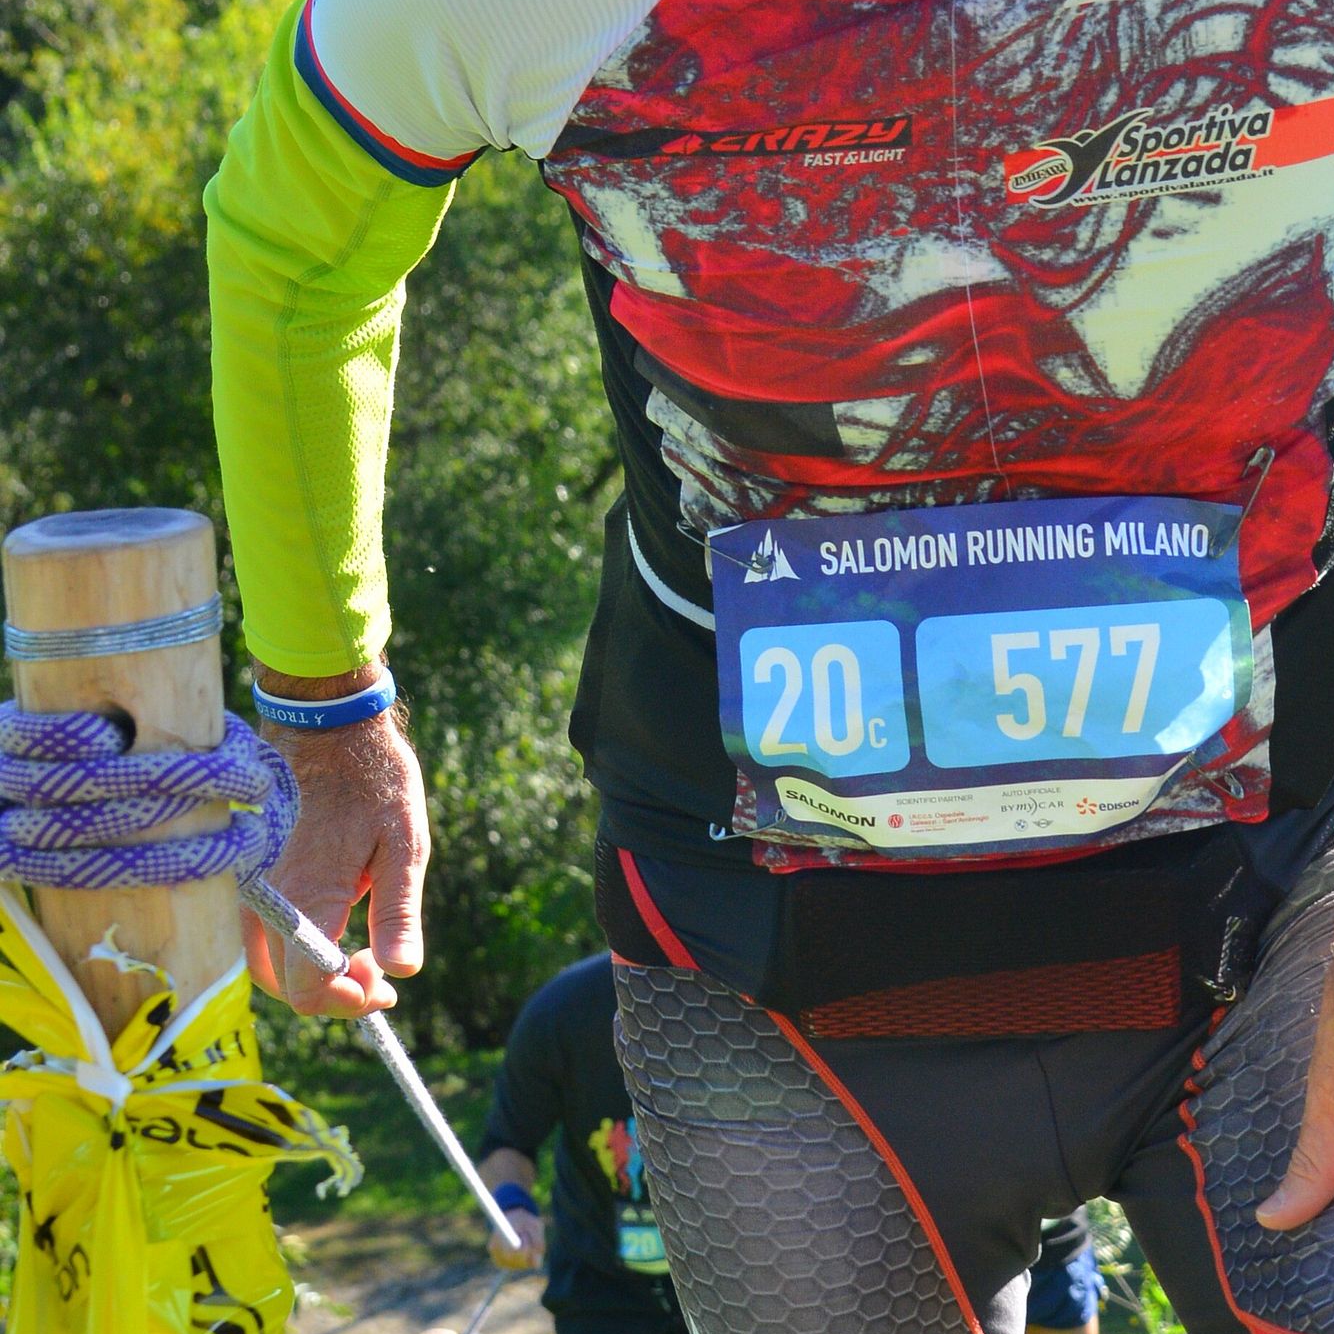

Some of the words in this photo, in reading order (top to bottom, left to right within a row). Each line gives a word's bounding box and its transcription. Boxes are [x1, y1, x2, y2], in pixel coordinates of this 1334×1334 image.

[710, 119, 907, 152] CRAZY
[1121, 107, 1271, 160] Sportiva
[1097, 142, 1252, 190] Lanzada
[1073, 168, 1275, 205] www.sportivalanzada.it
[820, 533, 958, 575] SALOMON
[966, 523, 1095, 566] RUNNING
[1103, 521, 1209, 559] MILANO
[990, 623, 1161, 741] 577
[785, 789, 876, 828] SALOMON
[896, 797, 937, 806] SCIENTIFIC
[938, 794, 974, 803] PARTNER
[1002, 789, 1023, 798] AUTO
[1024, 787, 1061, 796] UFFICIALE
